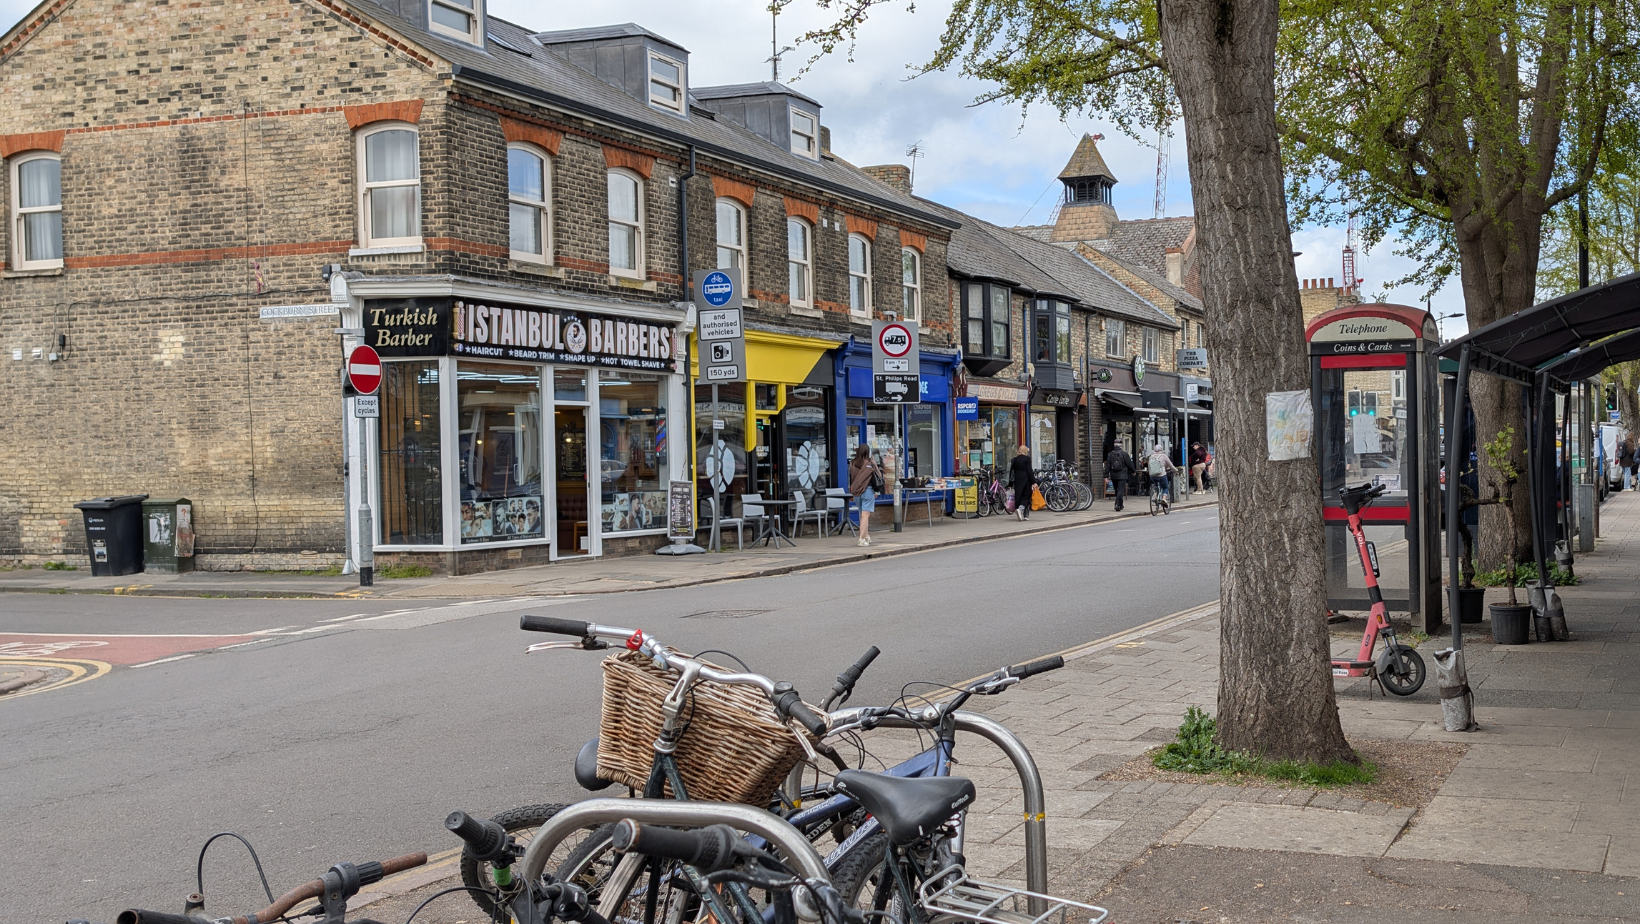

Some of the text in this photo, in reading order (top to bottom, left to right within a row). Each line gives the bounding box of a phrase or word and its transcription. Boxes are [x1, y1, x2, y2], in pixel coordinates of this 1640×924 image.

[261, 304, 336, 317] COCKBURN STREET
[370, 306, 438, 326] Turkish
[702, 320, 738, 328] authorised
[1339, 324, 1388, 336] Telephone
[375, 329, 433, 347] Barber
[465, 304, 670, 360] ISTANBUL BARBERS
[1334, 344, 1356, 352] Coins
[1358, 343, 1366, 352] &
[1368, 342, 1392, 351] Cards
[472, 346, 660, 368] HAIRCUT BEARD TRIM SHAPE UP HOT TOWEL SHAVE
[980, 386, 1018, 400] GREGS CYCLES
